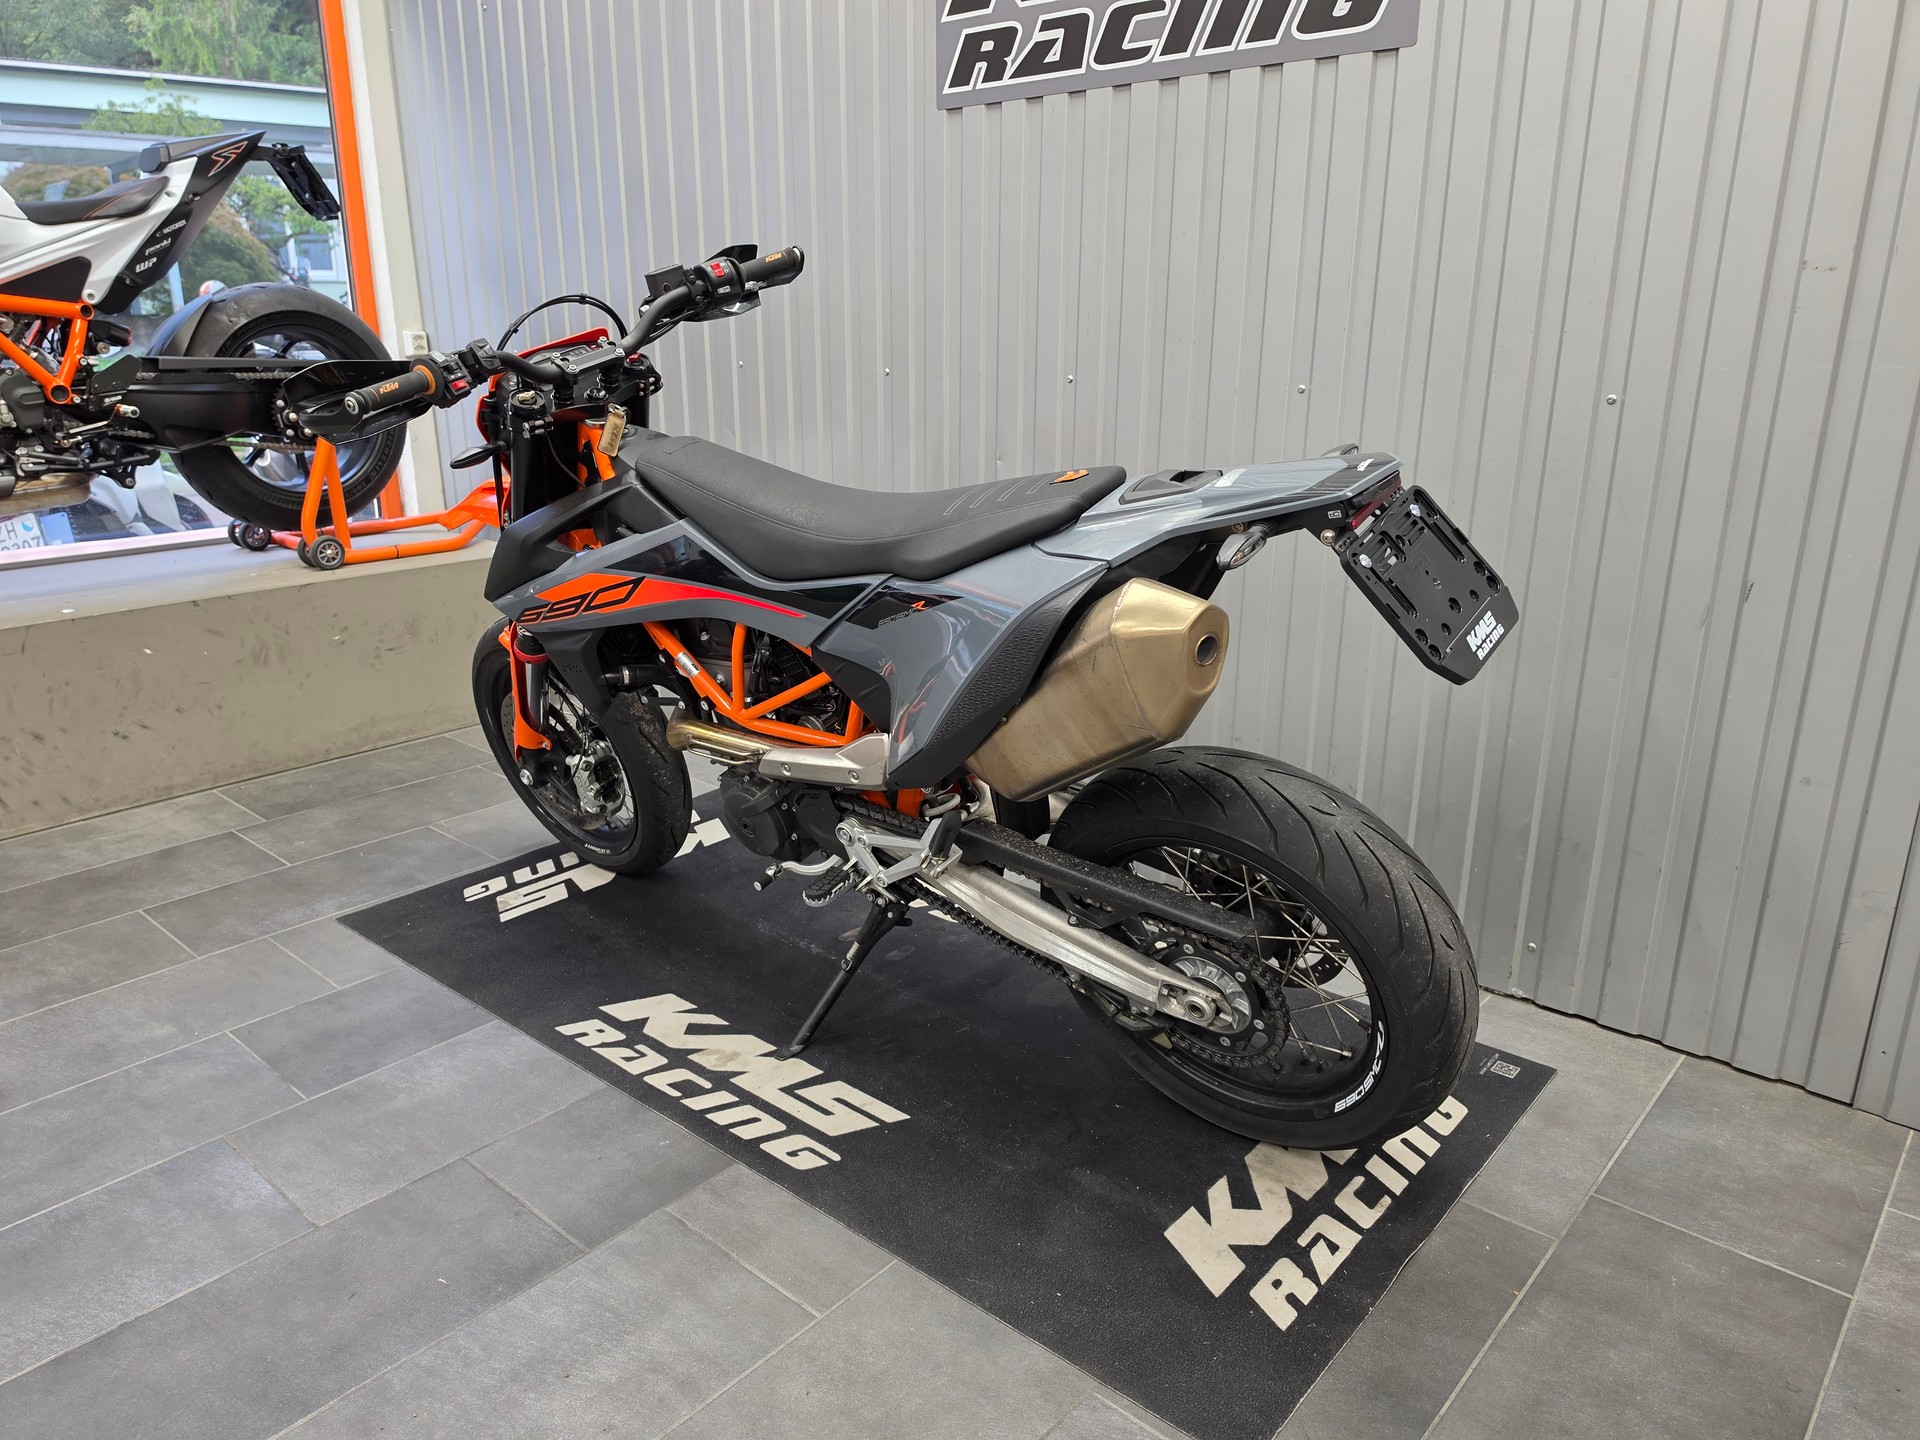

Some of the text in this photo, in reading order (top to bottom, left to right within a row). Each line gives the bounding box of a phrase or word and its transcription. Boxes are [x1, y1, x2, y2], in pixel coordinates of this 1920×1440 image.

[379, 381, 400, 395] KTM
[514, 575, 647, 624] 690
[1466, 610, 1497, 653] KMS
[599, 993, 912, 1137] KMS
